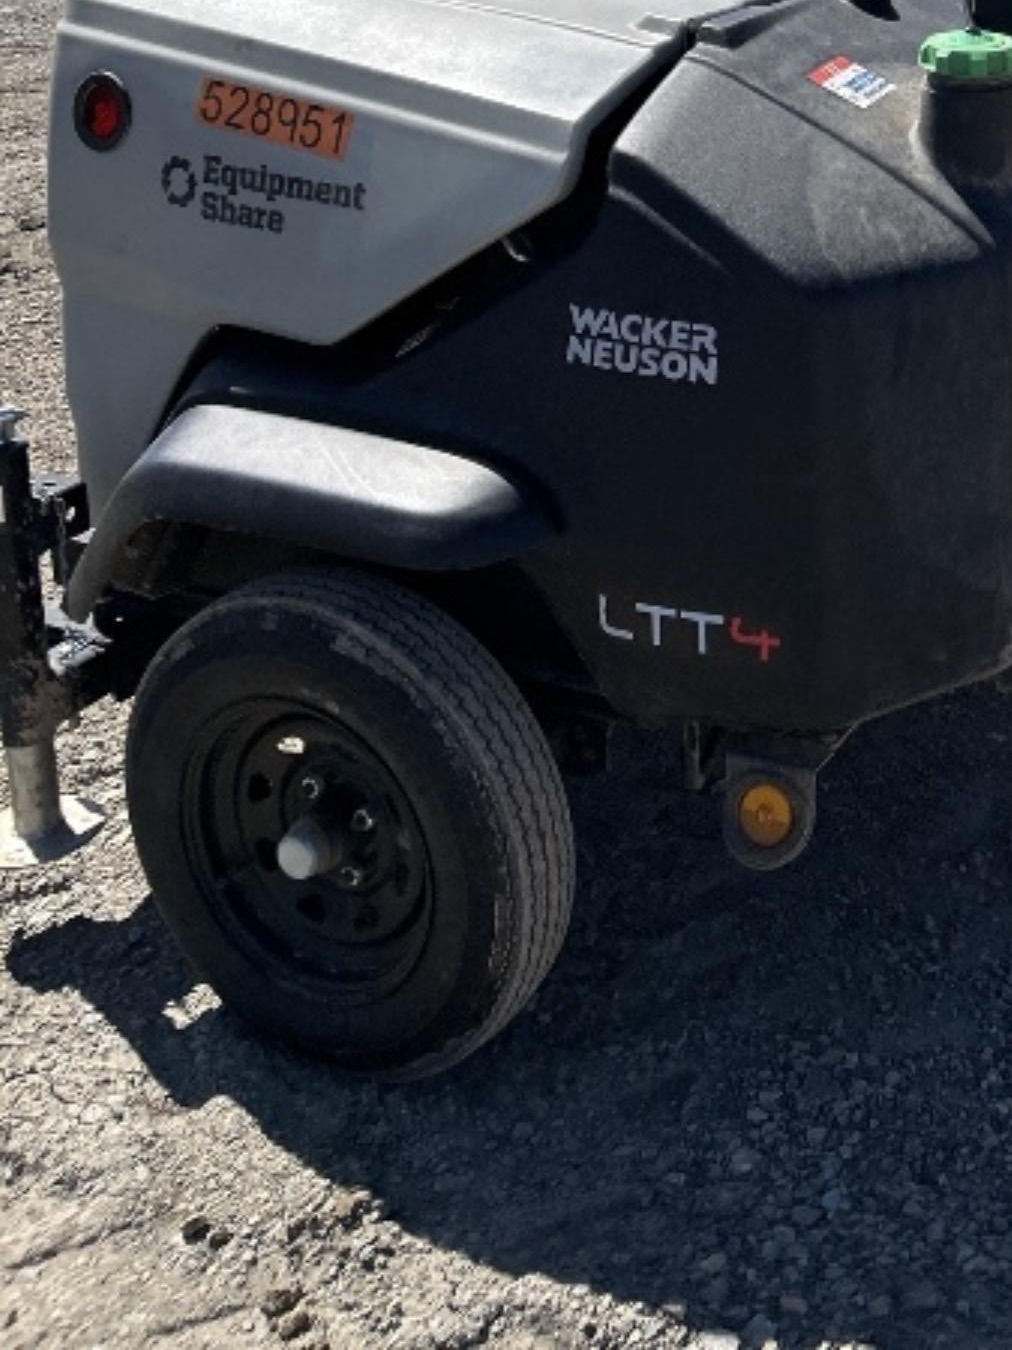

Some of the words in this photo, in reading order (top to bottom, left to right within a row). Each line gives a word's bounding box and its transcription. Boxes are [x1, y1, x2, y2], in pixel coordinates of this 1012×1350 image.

[200, 80, 347, 154] 528951
[202, 155, 367, 211] Equipment
[199, 191, 285, 234] Share
[569, 303, 719, 353] WACKER
[566, 335, 719, 385] NEUSON
